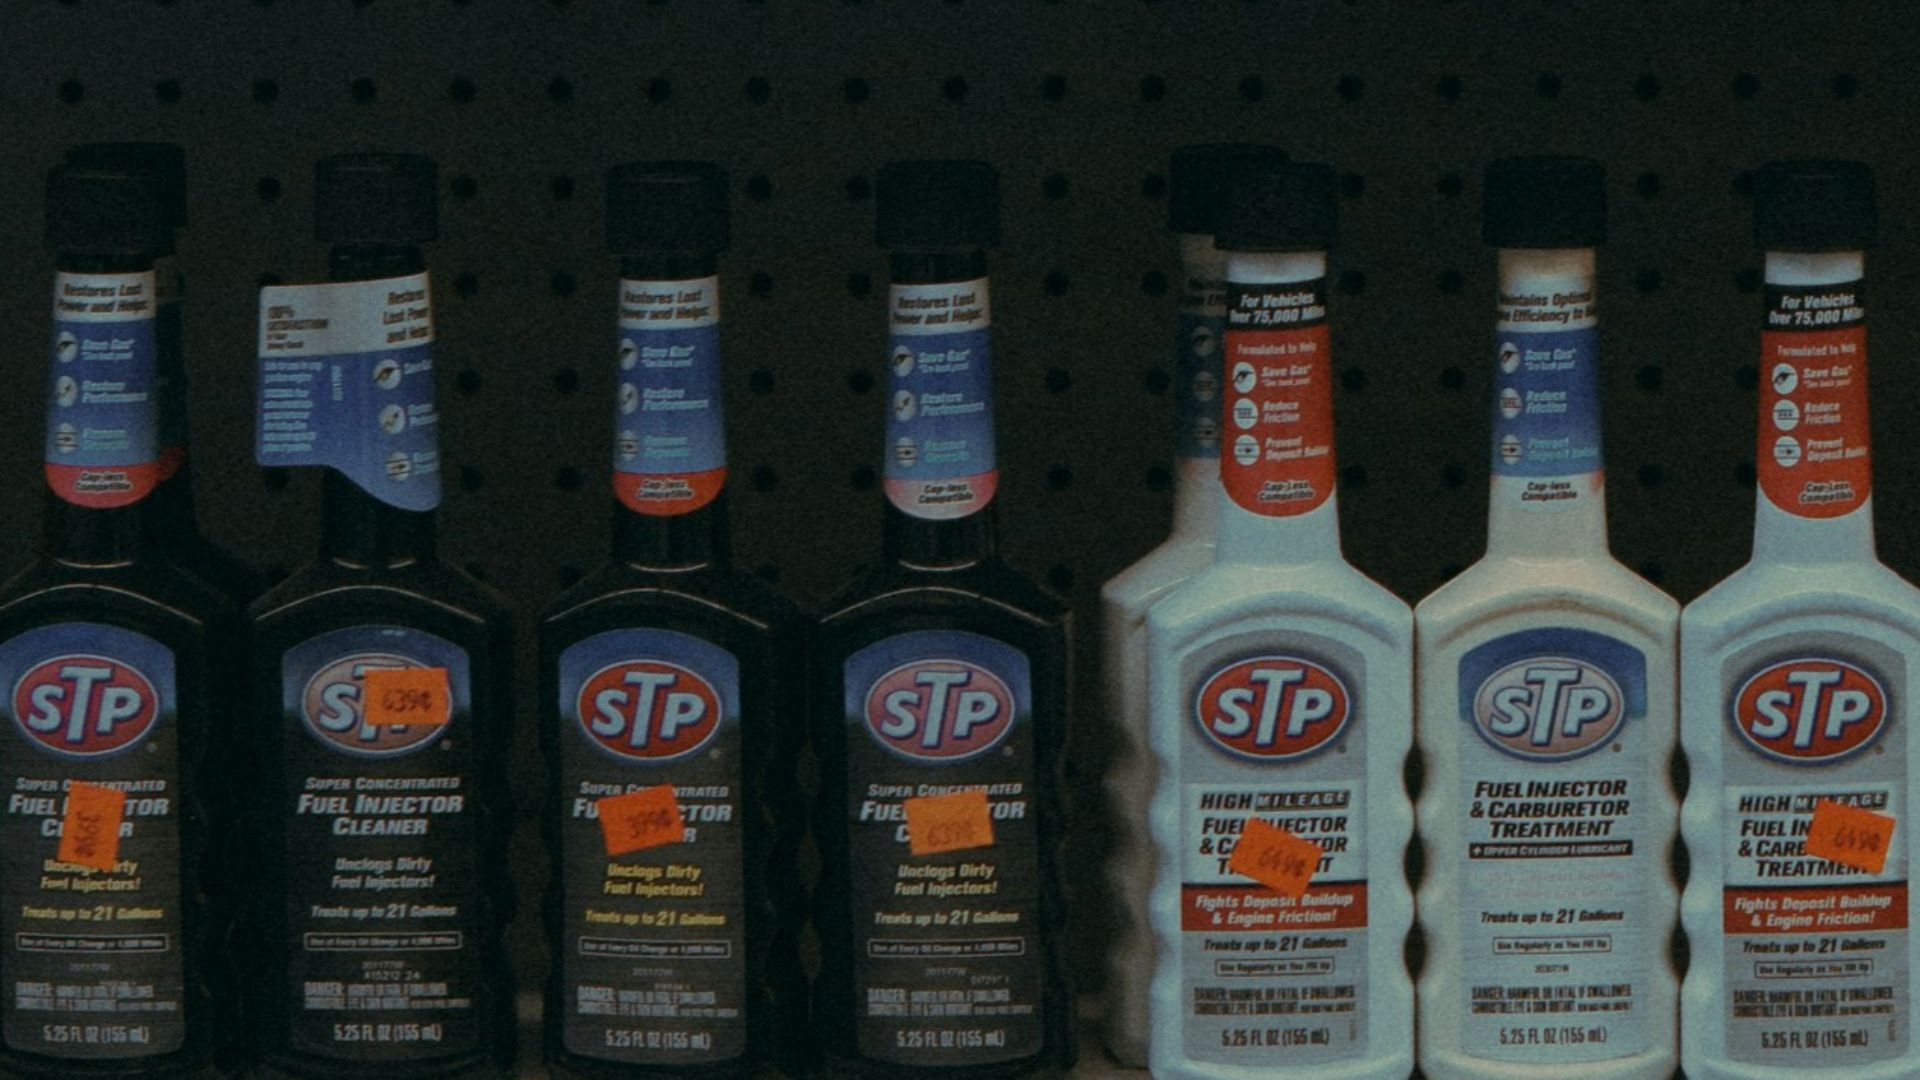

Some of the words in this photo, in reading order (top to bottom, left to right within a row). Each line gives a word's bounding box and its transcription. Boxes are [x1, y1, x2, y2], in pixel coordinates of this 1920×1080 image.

[678, 289, 702, 303] Lost
[953, 291, 976, 305] Lost
[1240, 293, 1260, 308] For
[1262, 291, 1316, 308] Vehicles
[1780, 295, 1801, 310] For
[1803, 293, 1856, 309] Vehicles
[650, 308, 673, 320] and
[925, 312, 948, 325] and
[1253, 308, 1300, 326] 75,000
[1513, 309, 1570, 325] Efficiency
[1573, 309, 1584, 320] to
[1768, 310, 1792, 326] Over
[1794, 308, 1841, 328] 75,000
[1524, 348, 1551, 360] Save
[1260, 366, 1288, 378] Save
[1803, 367, 1829, 378] Save
[1521, 491, 1578, 502] Compatible
[27, 666, 142, 743] STP
[592, 671, 706, 747] STP
[881, 671, 999, 748] STP
[1213, 669, 1334, 745] STP
[1489, 667, 1611, 746] STP
[1752, 671, 1871, 748] STP
[15, 777, 58, 792] SUPER
[305, 777, 351, 791] SUPER
[355, 777, 461, 790] CONCENTRATED
[580, 781, 622, 795] SUPER
[868, 784, 913, 797] SUPER
[1474, 780, 1524, 799] FUEL
[1527, 779, 1628, 798] INJECTOR
[8, 794, 57, 815] FUEL
[297, 794, 350, 815] FUEL
[354, 794, 464, 815] INJECTOR
[1200, 792, 1252, 810] HIGH
[1256, 791, 1349, 811] MILEAGE
[1470, 800, 1484, 819] &
[1488, 799, 1630, 818] CARBURETOR
[1739, 796, 1791, 812] HIGH
[332, 817, 429, 836] CLEANER
[1490, 819, 1615, 839] TREATMENT
[1741, 819, 1787, 836] FUEL
[1199, 838, 1213, 855] &
[1571, 842, 1628, 856] LUBRICANT
[1738, 840, 1752, 857] &
[335, 857, 393, 873] Unclogs
[395, 856, 433, 873] Dirty
[607, 863, 663, 880] Unclogs
[666, 864, 702, 881] Dirty
[898, 864, 956, 881] Unclogs
[959, 863, 996, 879] Dirty
[41, 876, 69, 890] Fuel
[71, 876, 141, 893] Injectors!
[332, 875, 362, 889] Fuel
[364, 875, 436, 892] Injectors!
[603, 881, 632, 895] Fuel
[635, 882, 704, 898] Injectors!
[894, 882, 924, 895] Fuel
[927, 881, 998, 898] Injectors!
[1195, 894, 1239, 912] Fights
[1243, 894, 1297, 910] Deposit
[1301, 892, 1354, 907] Buildup
[1735, 897, 1777, 913] Fights
[1781, 896, 1836, 912] Deposit
[1839, 894, 1893, 909] Buildup
[22, 905, 58, 919] Treats
[60, 909, 76, 921] up
[78, 907, 92, 920] to
[93, 905, 114, 921] 21
[116, 907, 164, 920] Gallons
[311, 905, 350, 918] Treats
[352, 907, 369, 920] up
[371, 906, 385, 918] to
[386, 904, 408, 918] 21
[410, 906, 457, 918] Gallons
[585, 909, 621, 923] Treats
[623, 913, 640, 925] up
[641, 912, 654, 924] to
[656, 910, 676, 926] 21
[679, 913, 727, 925] Gallons
[874, 912, 912, 925] Treats
[914, 914, 931, 926] up
[933, 913, 948, 925] to
[950, 910, 970, 925] 21
[972, 911, 1020, 924] Gallons
[1211, 912, 1224, 925] &
[1227, 911, 1275, 928] Engine
[1278, 908, 1338, 924] Friction!
[1481, 911, 1519, 924] Treats
[1521, 914, 1537, 925] up
[1540, 912, 1553, 923] to
[1556, 909, 1575, 924] 21
[1579, 910, 1624, 922] Gallons
[1751, 914, 1762, 927] &
[1766, 913, 1813, 929] Engine
[1817, 911, 1875, 926] Friction!
[1204, 938, 1241, 951] Treats
[1244, 940, 1260, 953] up
[1263, 938, 1277, 951] to
[1279, 936, 1299, 952] 21
[1302, 937, 1347, 949] Gallons
[1743, 941, 1780, 953] Treats
[1784, 943, 1799, 954] up
[1802, 941, 1815, 952] to
[1818, 938, 1837, 953] 21
[1841, 939, 1886, 951] Gallons
[334, 1024, 360, 1041] 5.25
[362, 1024, 375, 1041] FL
[377, 1024, 391, 1041] OZ
[393, 1024, 420, 1042] (155
[422, 1024, 443, 1042] mL)
[605, 1029, 631, 1046] 5.25
[632, 1030, 645, 1047] FL
[647, 1031, 661, 1048] OZ
[663, 1031, 689, 1050] (155
[691, 1031, 711, 1050] mL)
[896, 1030, 923, 1048] 5.25
[925, 1030, 938, 1048] FL
[940, 1030, 954, 1048] OZ
[956, 1030, 982, 1049] (155
[984, 1029, 1005, 1048] mL)
[1222, 1028, 1248, 1046] 5.25
[1250, 1028, 1263, 1046] FL
[1266, 1028, 1280, 1046] OZ
[1282, 1028, 1308, 1047] (155
[1310, 1027, 1330, 1046] mL)
[1500, 1028, 1526, 1045] 5.25
[1528, 1028, 1540, 1045] FL
[1543, 1028, 1557, 1044] OZ
[1560, 1027, 1586, 1045] (155
[1588, 1027, 1608, 1043] mL)
[1761, 1031, 1787, 1048] 5.25
[1789, 1031, 1802, 1048] FL
[1805, 1031, 1819, 1047] OZ
[1821, 1030, 1847, 1048] (155
[1849, 1029, 1869, 1047] mL)
